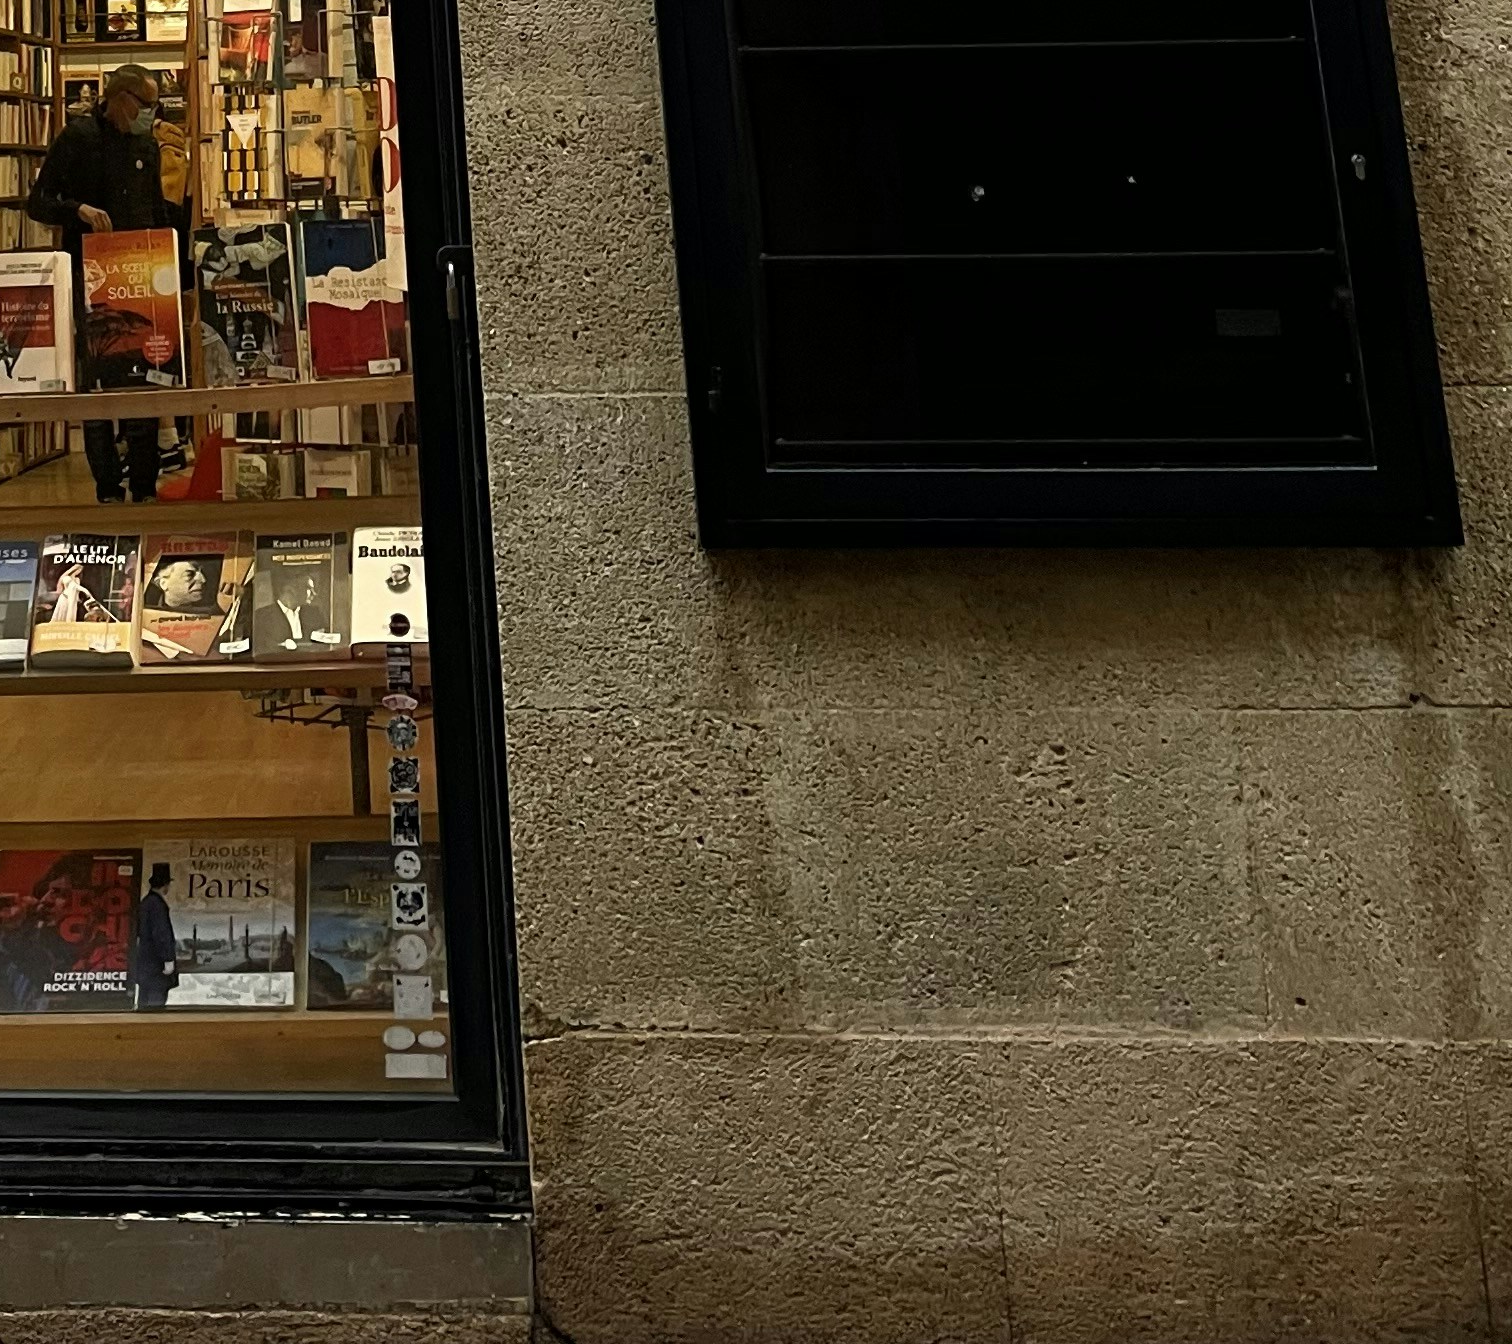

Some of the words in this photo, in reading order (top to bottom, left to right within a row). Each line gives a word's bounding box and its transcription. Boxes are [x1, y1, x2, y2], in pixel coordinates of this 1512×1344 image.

[105, 262, 120, 275] LA
[107, 285, 155, 301] SOLEIL
[216, 301, 229, 315] la
[231, 298, 275, 314] Russie
[73, 544, 88, 554] LE
[89, 544, 110, 555] LIT
[272, 538, 302, 550] Kamel
[189, 845, 271, 858] LAROUSSE
[187, 872, 271, 899] Paris
[53, 970, 128, 982] DIZZIDENCE
